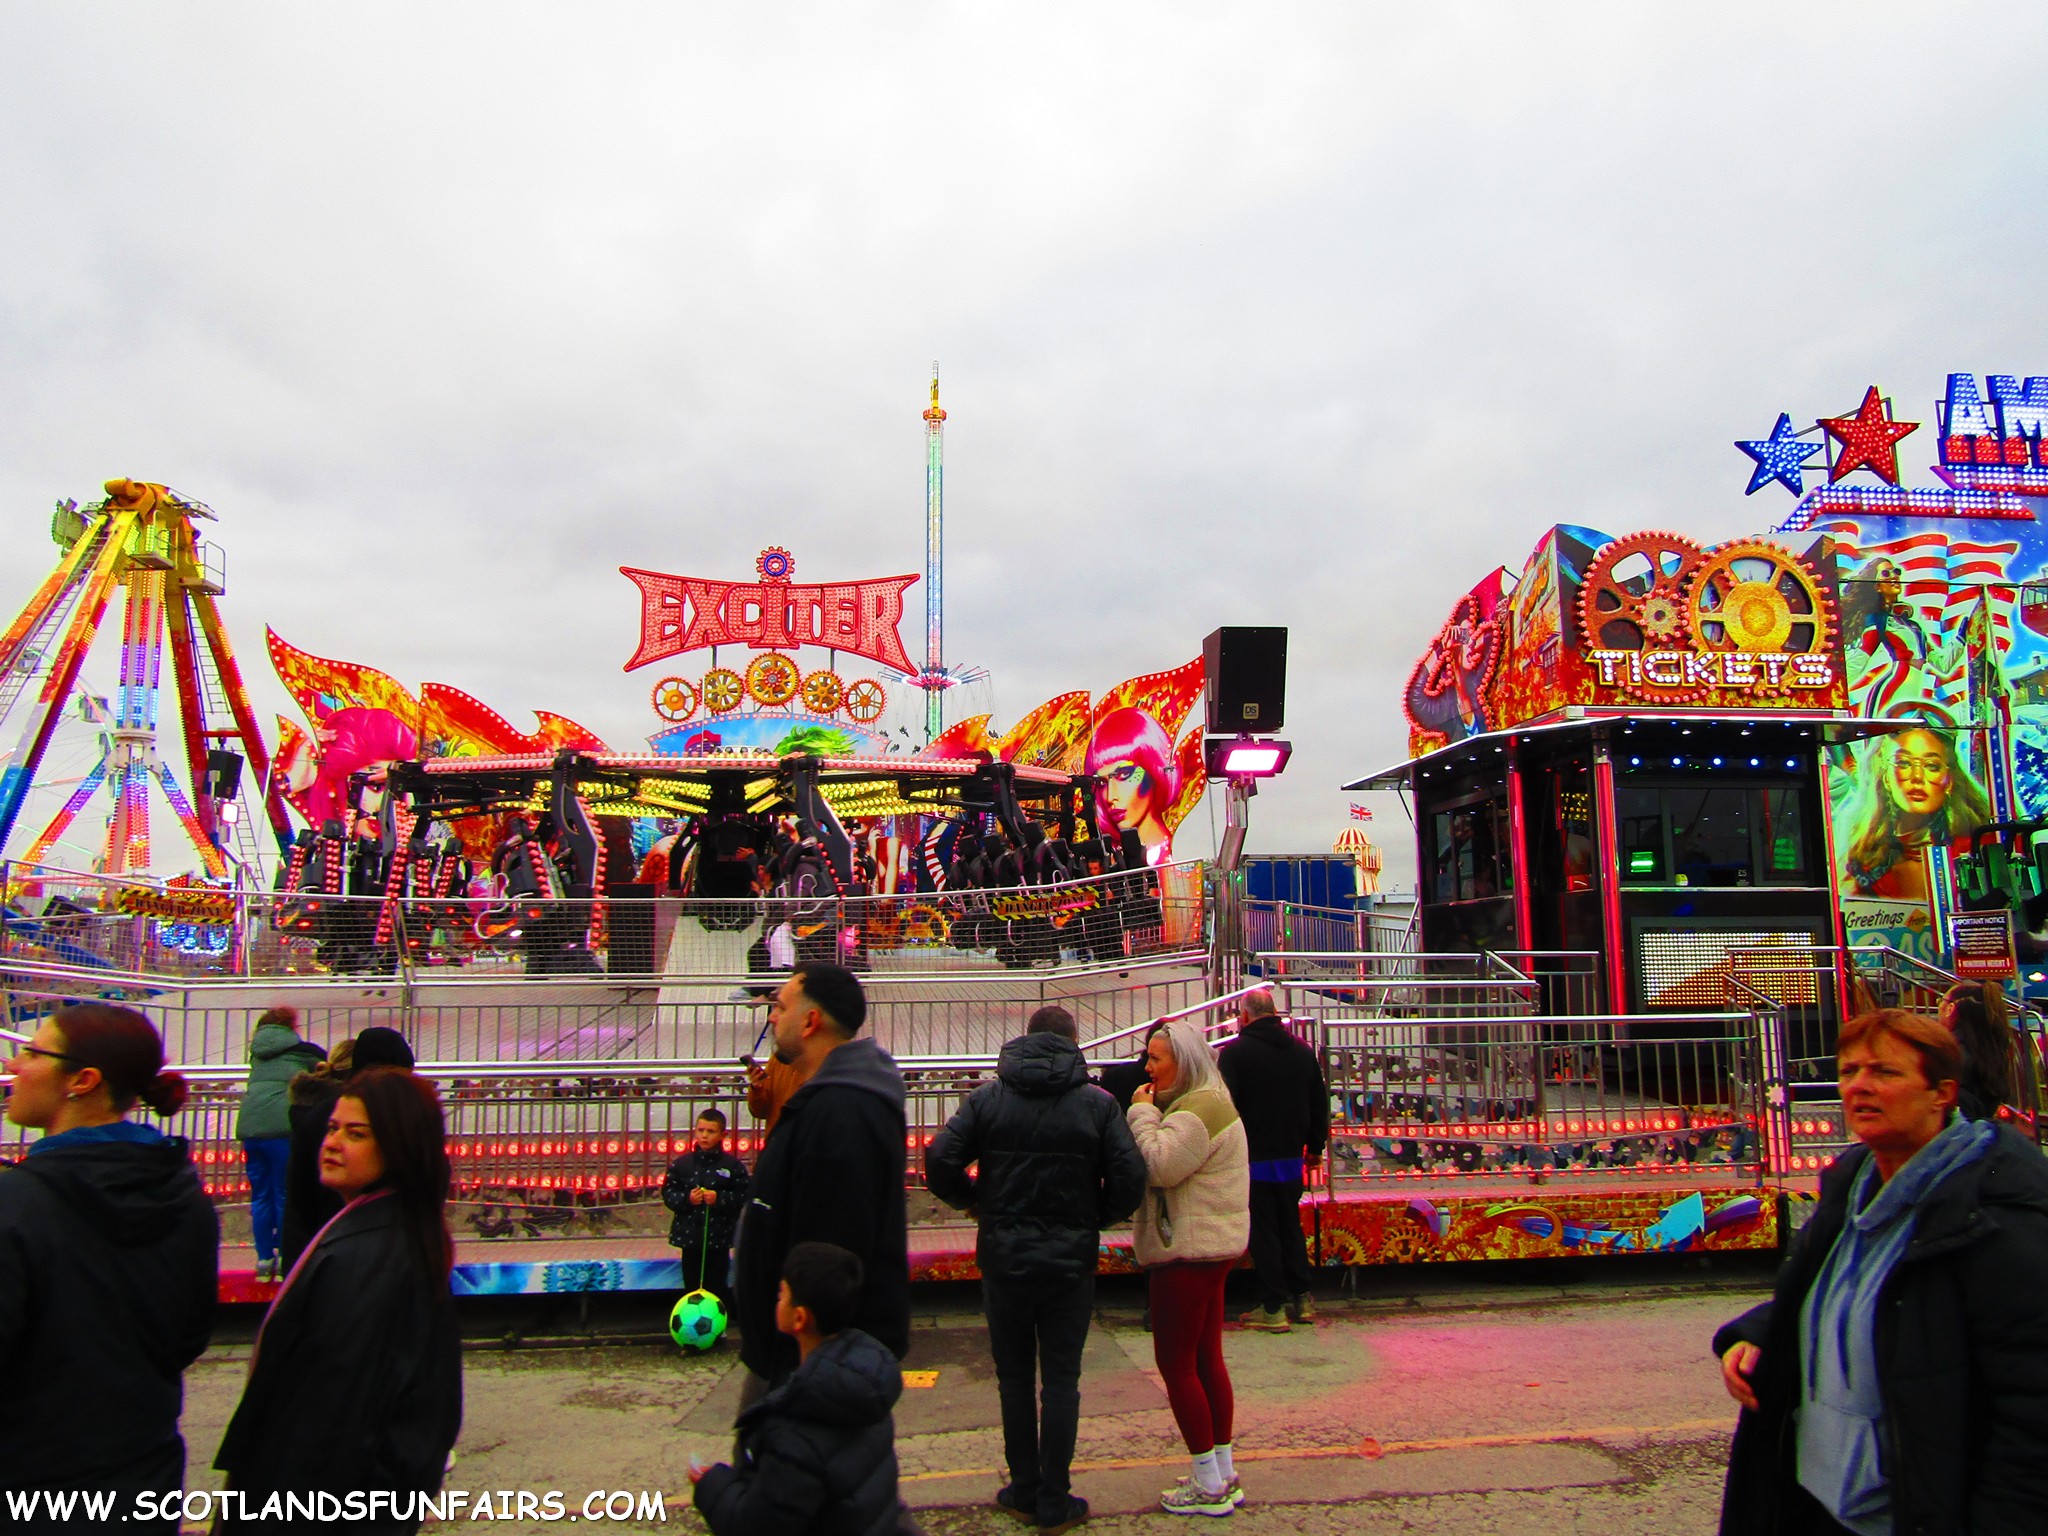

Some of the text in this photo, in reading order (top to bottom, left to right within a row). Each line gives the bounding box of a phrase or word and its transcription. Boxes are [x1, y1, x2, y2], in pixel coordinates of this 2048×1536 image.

[619, 565, 921, 678] EXCITER
[1585, 649, 1833, 689] TICKETS
[1005, 899, 1054, 913] DANGER
[1056, 894, 1086, 909] ZONE
[1846, 909, 1905, 930] Greetings
[1985, 916, 2005, 924] NOTICE
